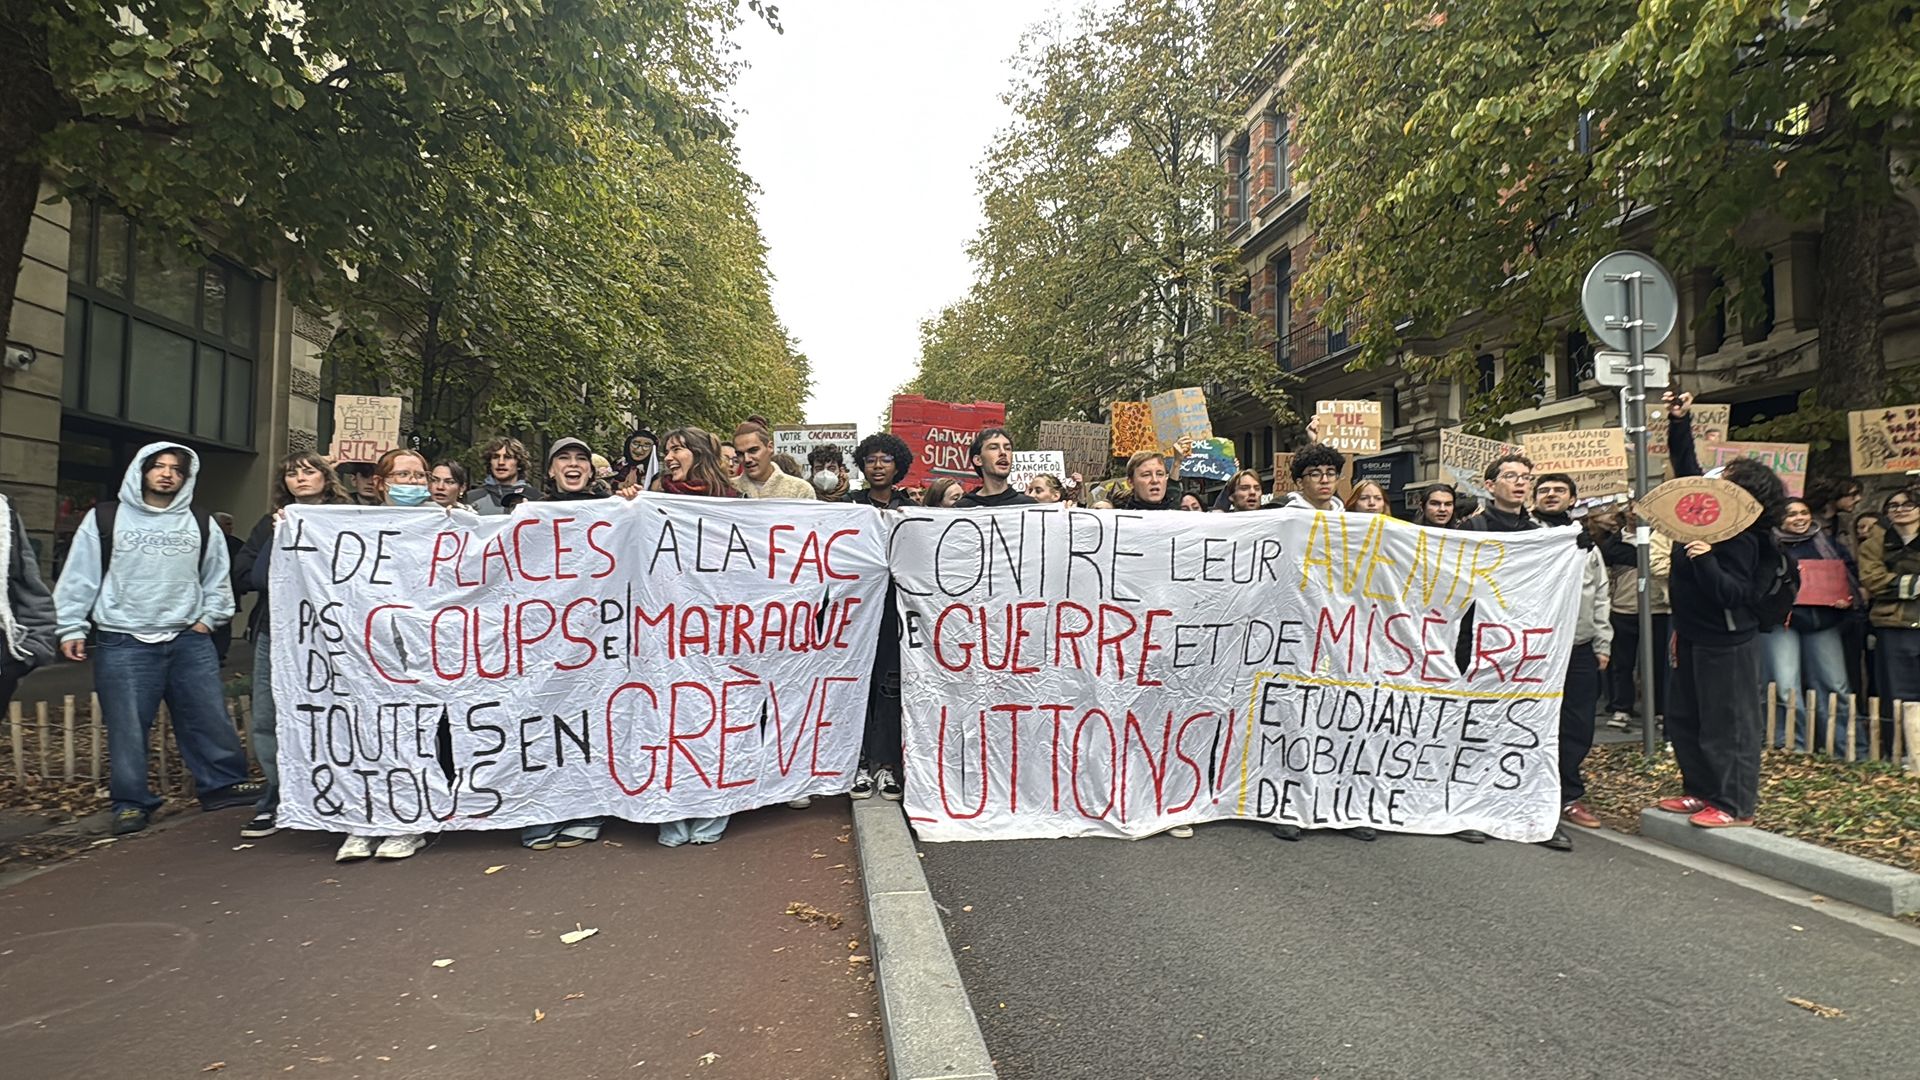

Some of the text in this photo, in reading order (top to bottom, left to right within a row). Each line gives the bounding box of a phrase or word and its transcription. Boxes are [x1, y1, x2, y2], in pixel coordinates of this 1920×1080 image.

[357, 397, 380, 406] BE
[1320, 402, 1378, 414] LA POLICE
[344, 417, 392, 431] BUT
[1333, 413, 1364, 425] TUE
[1041, 424, 1061, 434] JUST
[779, 432, 802, 441] VOTRE
[1529, 430, 1610, 443] DEPUIS QUAND
[338, 440, 389, 461] RICH
[777, 446, 788, 454] JE
[1322, 438, 1376, 450] COUVRE
[1530, 439, 1607, 454] LA FRANCE
[921, 444, 975, 469] SURV
[1011, 454, 1052, 463] LLE SE
[1532, 452, 1549, 460] EST
[1010, 464, 1050, 472] BRANCHE
[1011, 473, 1022, 482] LA
[331, 530, 402, 585] DE
[428, 518, 616, 587] PLACES
[696, 517, 756, 573] LA
[768, 524, 860, 584] FAC
[888, 509, 1509, 609] CONTRE LEUR AVENIR
[299, 599, 344, 644] PAS
[634, 598, 861, 659] MATRAQUE
[364, 597, 598, 684] COUPS
[933, 601, 1173, 686] GUERRE
[1173, 622, 1234, 668] ET
[1243, 619, 1303, 667] DE
[307, 649, 350, 696] DE
[520, 709, 591, 772] EN
[606, 665, 858, 797] GRÈVE
[311, 760, 503, 823] & TOUS
[1257, 778, 1406, 826] DE LILLE
